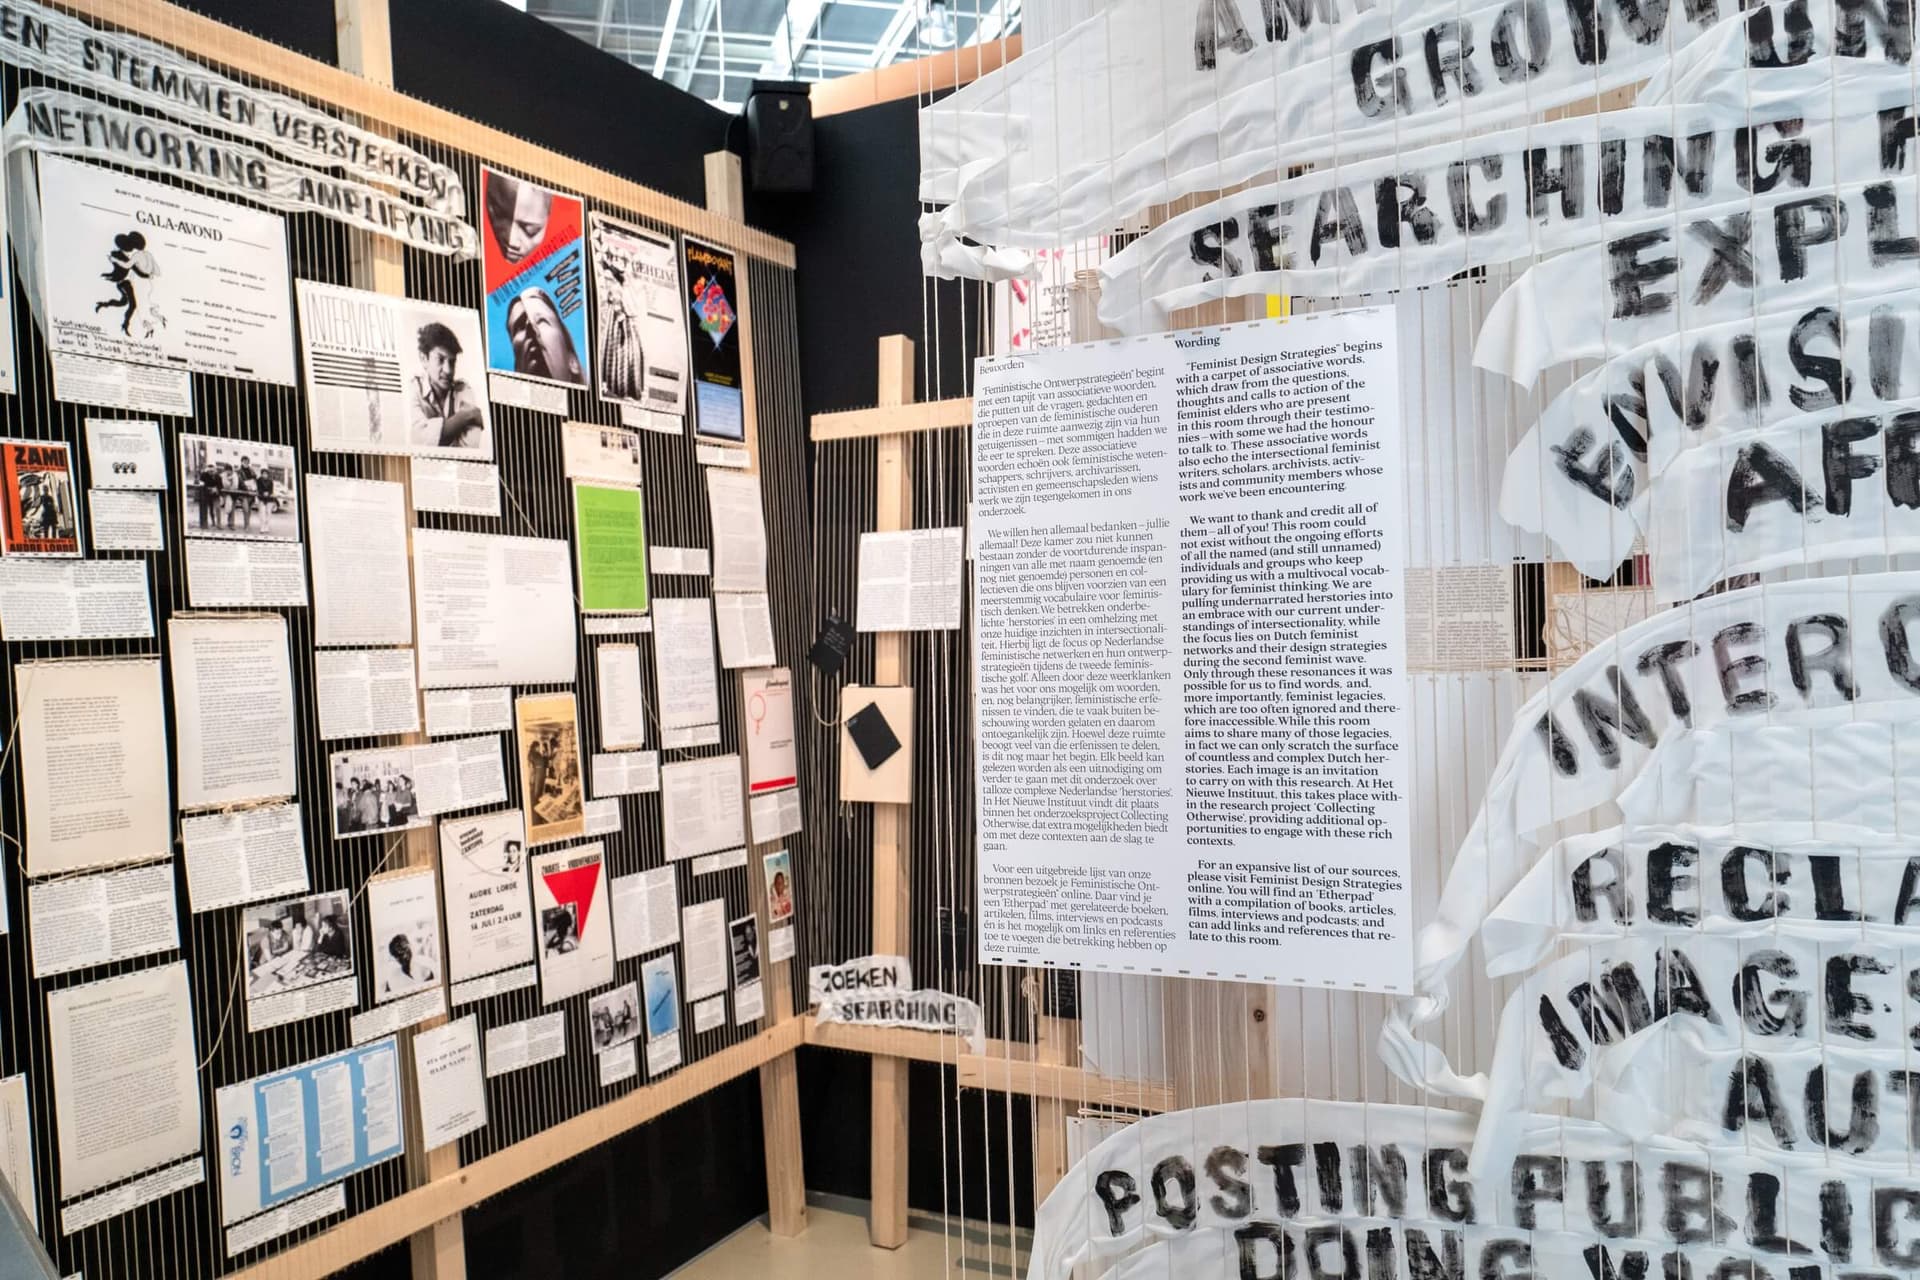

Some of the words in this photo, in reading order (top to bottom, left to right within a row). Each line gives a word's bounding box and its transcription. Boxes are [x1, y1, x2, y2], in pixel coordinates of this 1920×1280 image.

[24, 101, 268, 190] NETWORKING
[1190, 118, 1812, 283] SEARCHING
[305, 291, 396, 351] INTERVIEW
[1174, 336, 1220, 349] Wording
[1240, 353, 1277, 366] Design
[1343, 342, 1383, 354] begins
[1136, 367, 1164, 380] begint
[1176, 373, 1200, 385] with
[1202, 374, 1209, 382] a
[1211, 368, 1247, 381] carpet
[1249, 365, 1262, 377] of
[1263, 359, 1324, 375] associative
[1176, 383, 1209, 397] which
[1211, 380, 1239, 393] draw
[1241, 376, 1269, 390] from
[1271, 375, 1290, 386] the
[1177, 395, 1225, 409] thoughts
[1227, 391, 1248, 404] and
[1250, 388, 1277, 401] calls
[1279, 389, 1291, 399] to
[1293, 383, 1328, 396] action
[1331, 380, 1342, 391] of
[1346, 379, 1365, 392] the
[1177, 406, 1221, 421] feminist
[1224, 403, 1258, 416] elders
[1259, 400, 1284, 411] who
[1286, 397, 1305, 409] are
[1307, 393, 1351, 409] present
[1178, 424, 1188, 432] in
[1191, 419, 1212, 431] this
[1214, 417, 1244, 429] room
[1247, 411, 1291, 425] through
[1294, 407, 1322, 420] their
[1325, 404, 1375, 417] testimo-
[1236, 428, 1266, 440] some
[1267, 424, 1284, 435] we
[1286, 421, 1307, 434] had
[1309, 420, 1328, 431] the
[1331, 417, 1375, 429] honour
[1178, 447, 1189, 456] to
[1191, 443, 1213, 455] talk
[1230, 439, 1264, 451] These
[1266, 432, 1329, 448] associative
[1330, 428, 1368, 442] words
[1178, 456, 1200, 468] also
[1202, 454, 1229, 465] echo
[1231, 451, 1249, 463] the
[1251, 443, 1329, 461] intersectional
[1331, 440, 1381, 454] feminist
[1332, 453, 1365, 466] activ-
[1179, 481, 1198, 491] ists
[1199, 477, 1220, 490] and
[1222, 473, 1286, 488] community
[1288, 469, 1343, 482] members
[1345, 465, 1383, 477] whose
[1179, 491, 1206, 503] work
[1239, 488, 1266, 498] been
[1198, 859, 1217, 870] For
[1219, 862, 1233, 871] an
[1235, 862, 1291, 874] expansive
[1293, 863, 1311, 874] list
[1313, 864, 1326, 875] of
[1328, 867, 1349, 876] our
[1187, 870, 1222, 883] please
[1224, 872, 1248, 884] visit
[1250, 873, 1299, 886] Feminist
[1302, 876, 1340, 890] Design
[1343, 877, 1402, 892] Strategies
[1227, 884, 1247, 897] You
[1249, 885, 1270, 897] will
[1273, 886, 1297, 900] find
[1298, 888, 1313, 901] an
[470, 904, 504, 919] ZATERDAG
[1188, 894, 1212, 906] with
[1215, 898, 1222, 906] a
[1224, 896, 1291, 910] compilation
[1294, 900, 1307, 912] of
[1221, 908, 1279, 922] interviews
[1282, 912, 1304, 924] and
[1362, 917, 1385, 928] and
[1188, 920, 1208, 930] can
[1210, 920, 1232, 932] add
[1233, 921, 1261, 935] links
[1263, 923, 1285, 934] and
[1288, 925, 1349, 938] references
[1351, 928, 1375, 940] that
[1378, 932, 1395, 941] re-
[1189, 930, 1209, 942] late
[1211, 932, 1223, 942] to
[1225, 932, 1246, 944] this
[843, 998, 957, 1025] SEARCHING
[1095, 1141, 1475, 1237] POSTING
